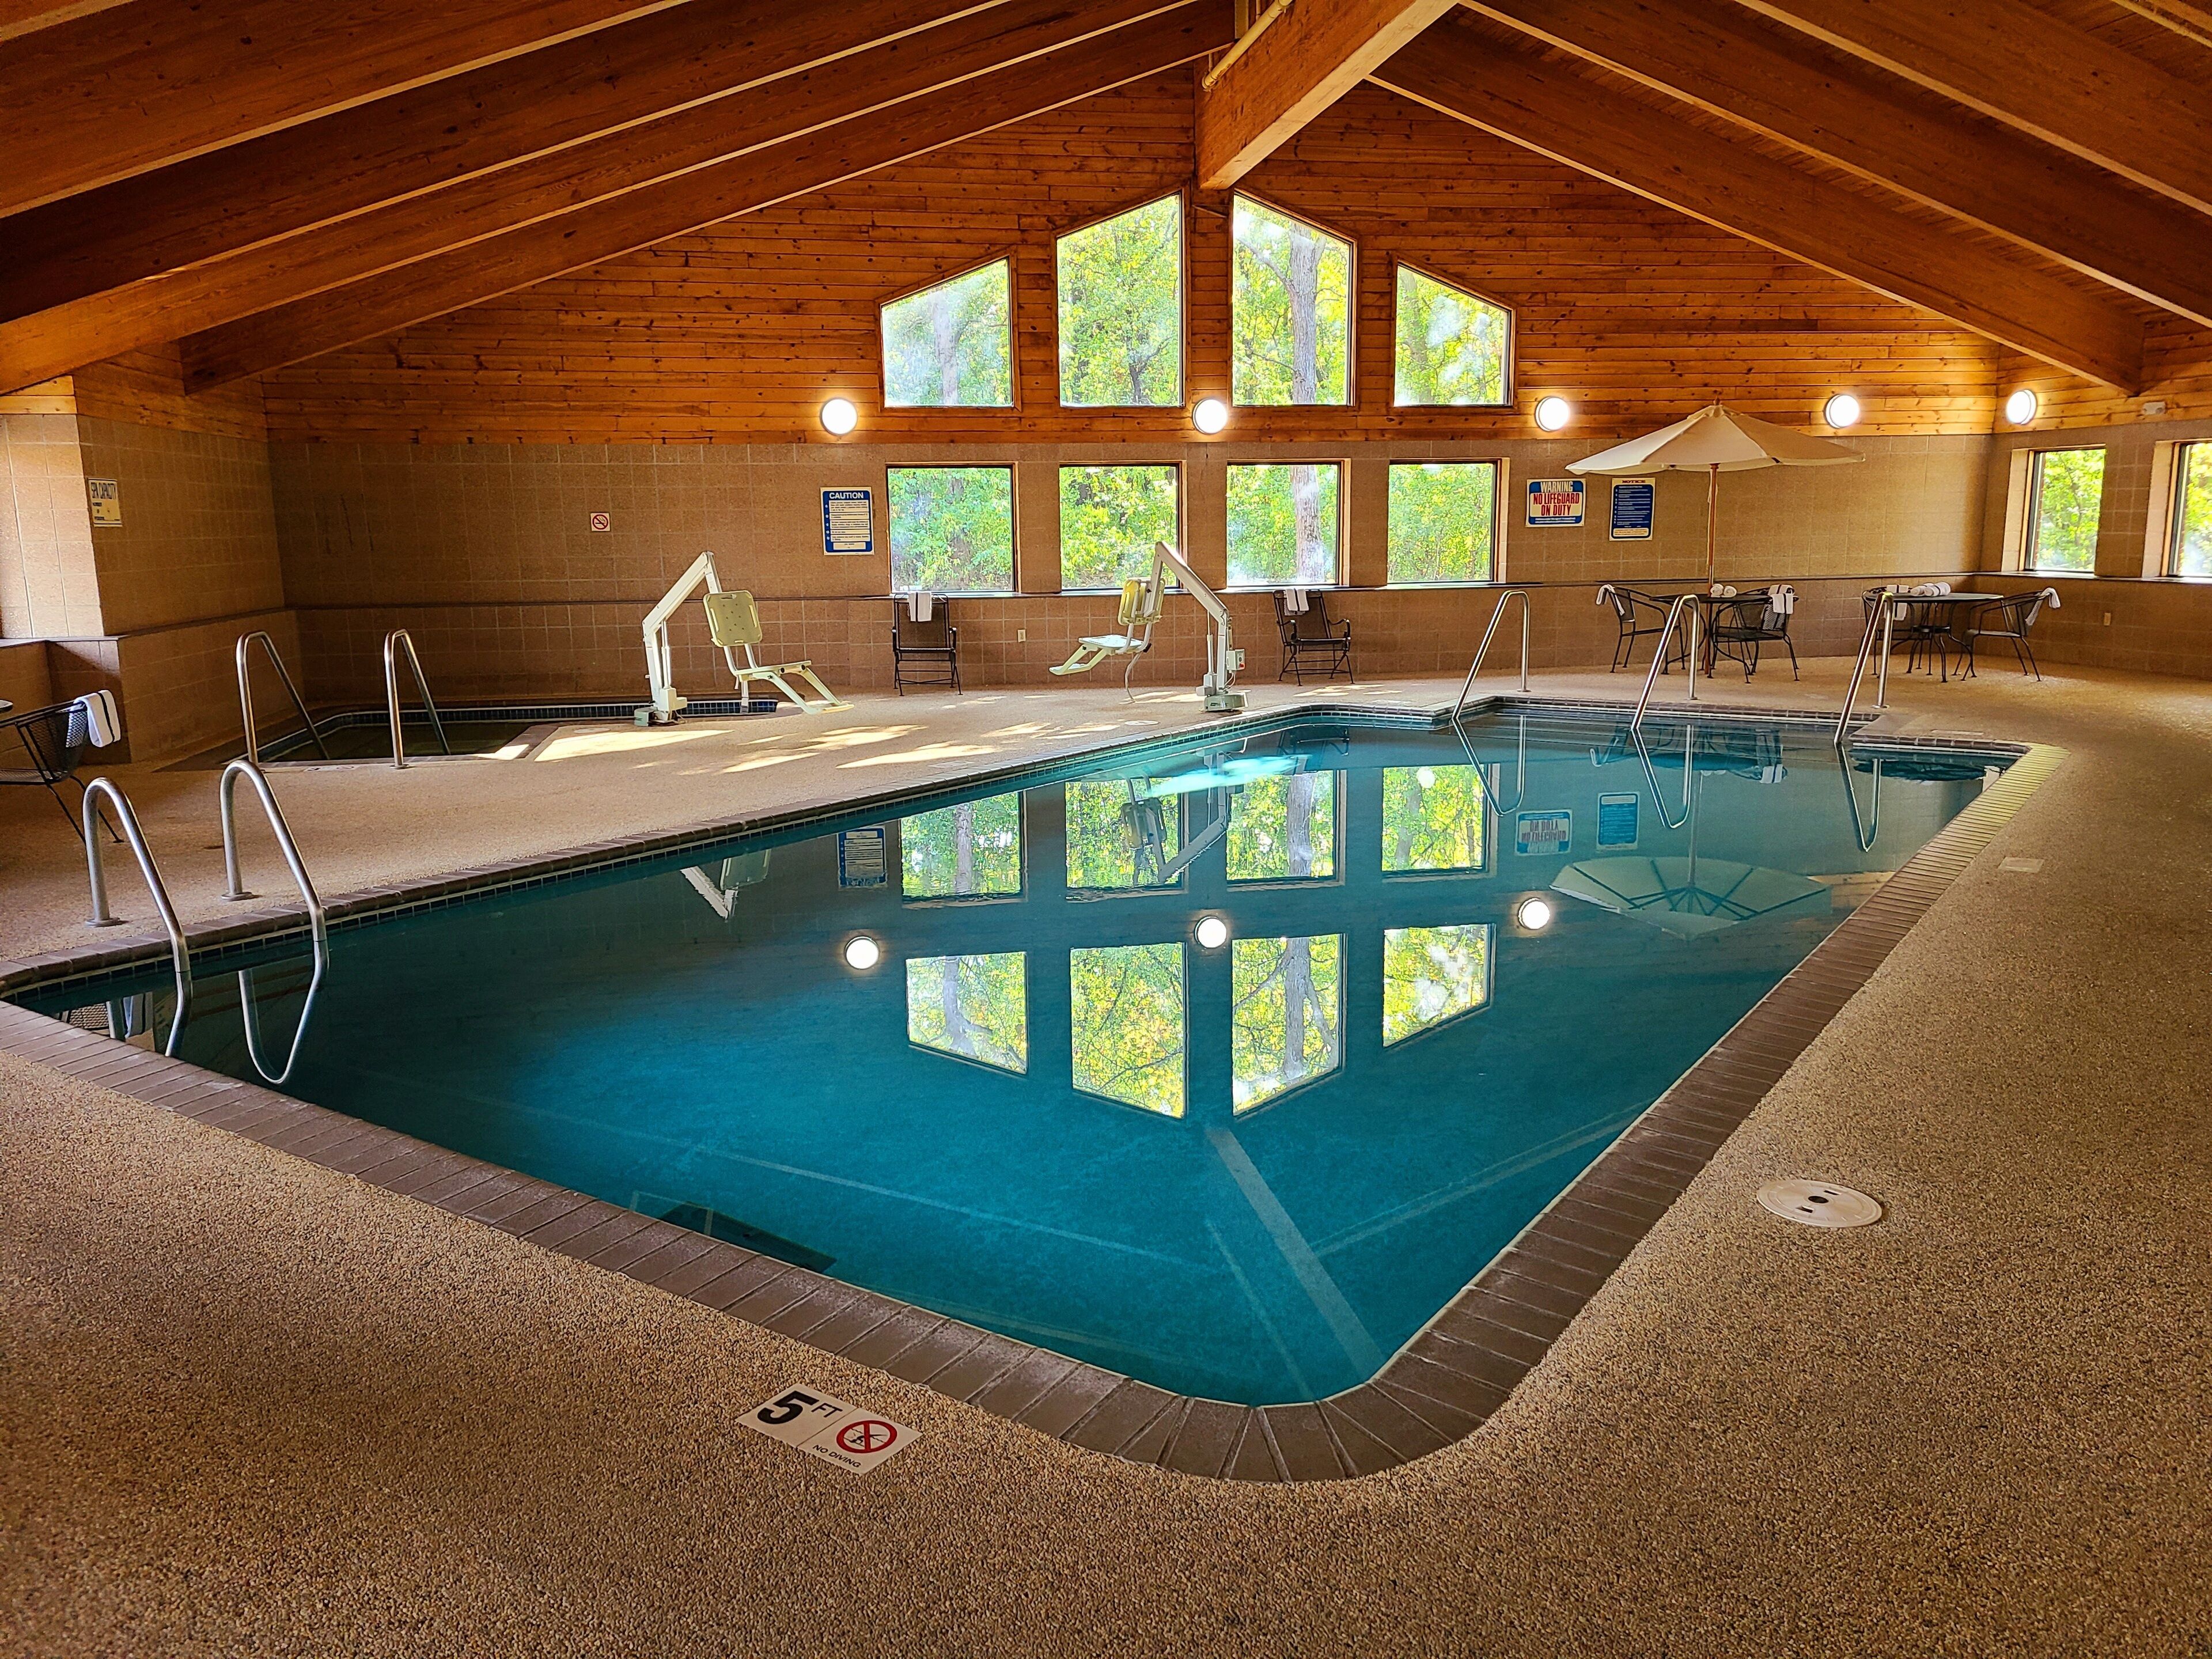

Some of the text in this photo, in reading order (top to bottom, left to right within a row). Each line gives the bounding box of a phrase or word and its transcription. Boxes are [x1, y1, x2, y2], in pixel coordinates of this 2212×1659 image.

[1540, 481, 1573, 493] WARNING
[1533, 493, 1580, 505] NO LIFEGUARD
[1541, 505, 1571, 516] ON DUTY
[757, 1390, 843, 1425] 5 FT
[812, 1444, 861, 1468] NO DIVING
